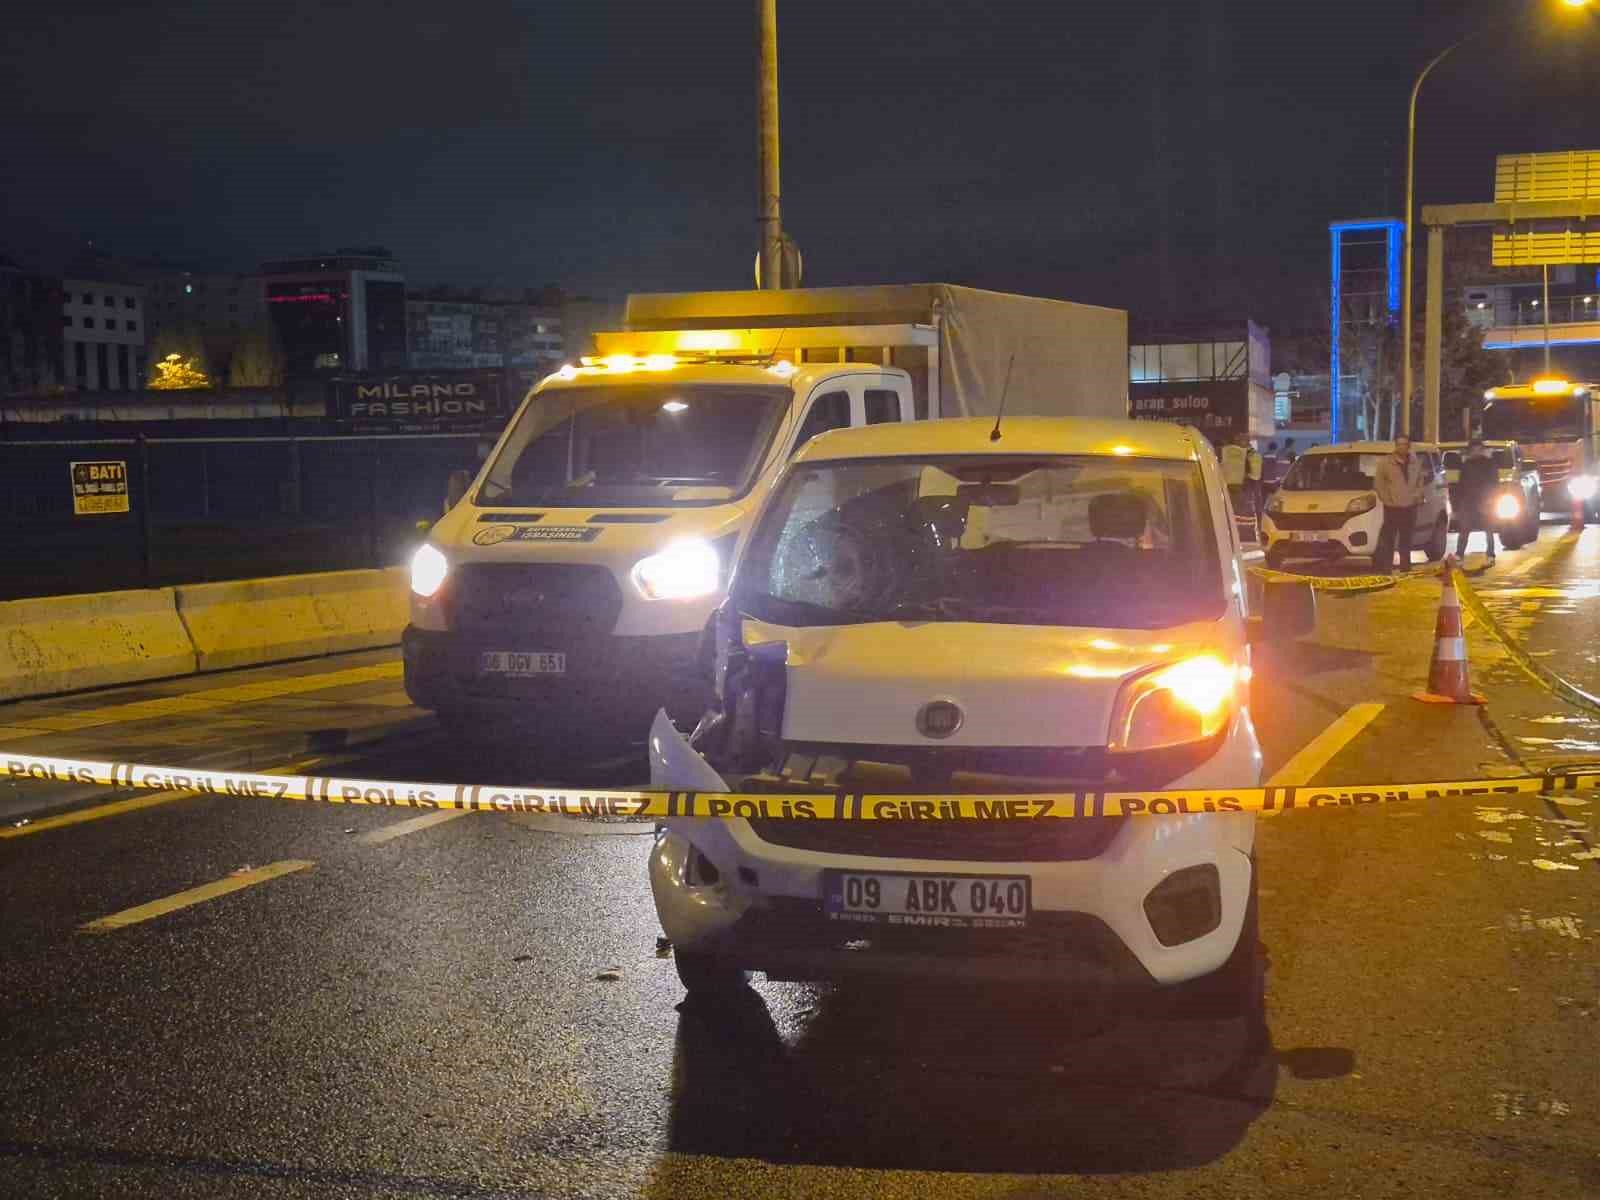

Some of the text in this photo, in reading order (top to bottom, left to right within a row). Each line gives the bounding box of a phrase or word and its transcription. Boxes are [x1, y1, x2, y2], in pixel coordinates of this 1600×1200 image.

[846, 877, 1024, 914] 09 ABK 040
